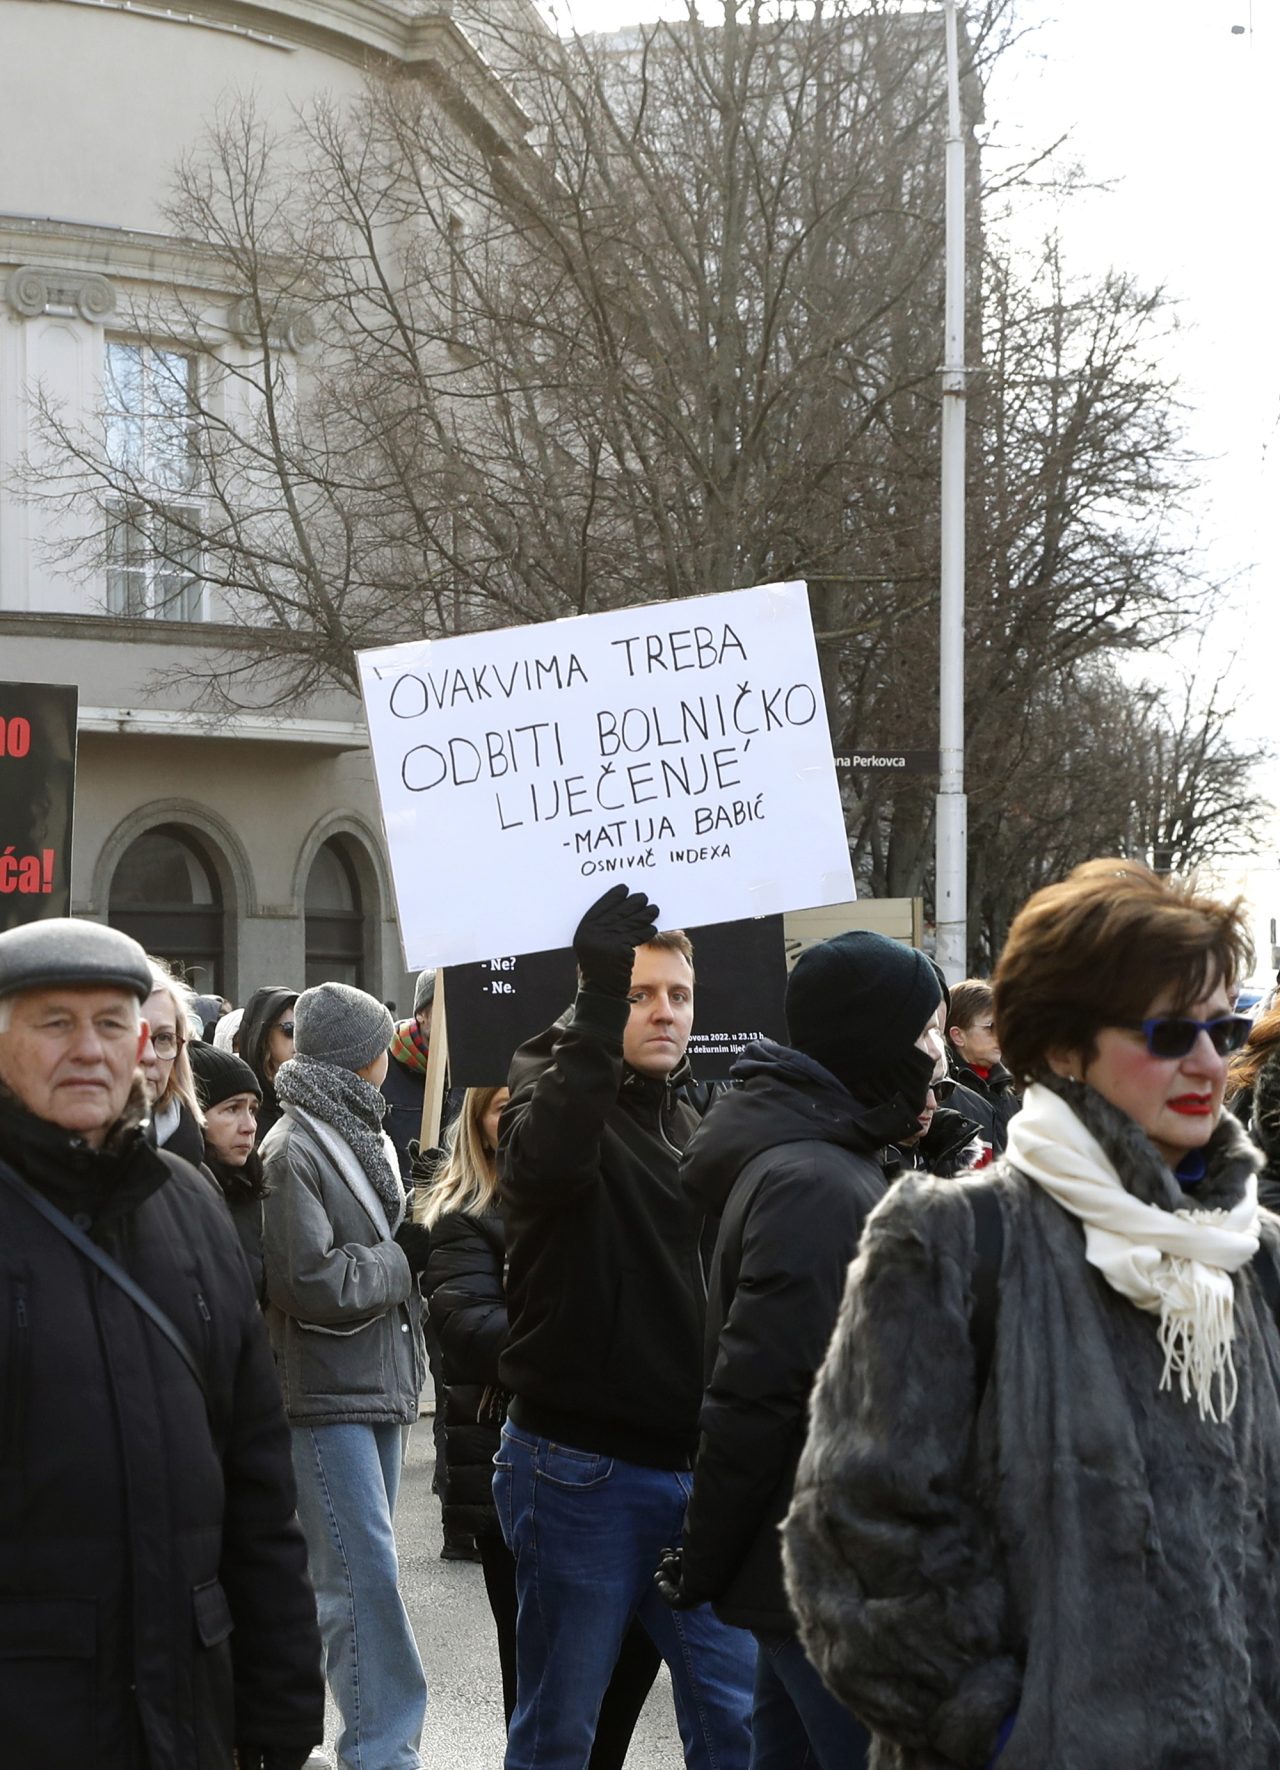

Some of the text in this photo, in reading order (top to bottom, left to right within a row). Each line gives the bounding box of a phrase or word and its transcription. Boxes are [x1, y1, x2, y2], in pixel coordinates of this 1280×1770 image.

[611, 624, 748, 677] TREBA
[401, 681, 816, 792] ODBITI BOLNIČKO
[853, 755, 906, 767] Perkovca
[695, 792, 766, 836] BABIĆ
[581, 844, 731, 876] OSNIVAČ INDEXA
[490, 957, 516, 971] Ne?
[491, 981, 516, 994] Ne.
[688, 1034, 709, 1042] ovoza
[710, 1033, 731, 1041] 2022.
[738, 1032, 758, 1040] 23.13
[693, 1045, 729, 1054] dežurnim
[730, 1044, 745, 1054] liječ
